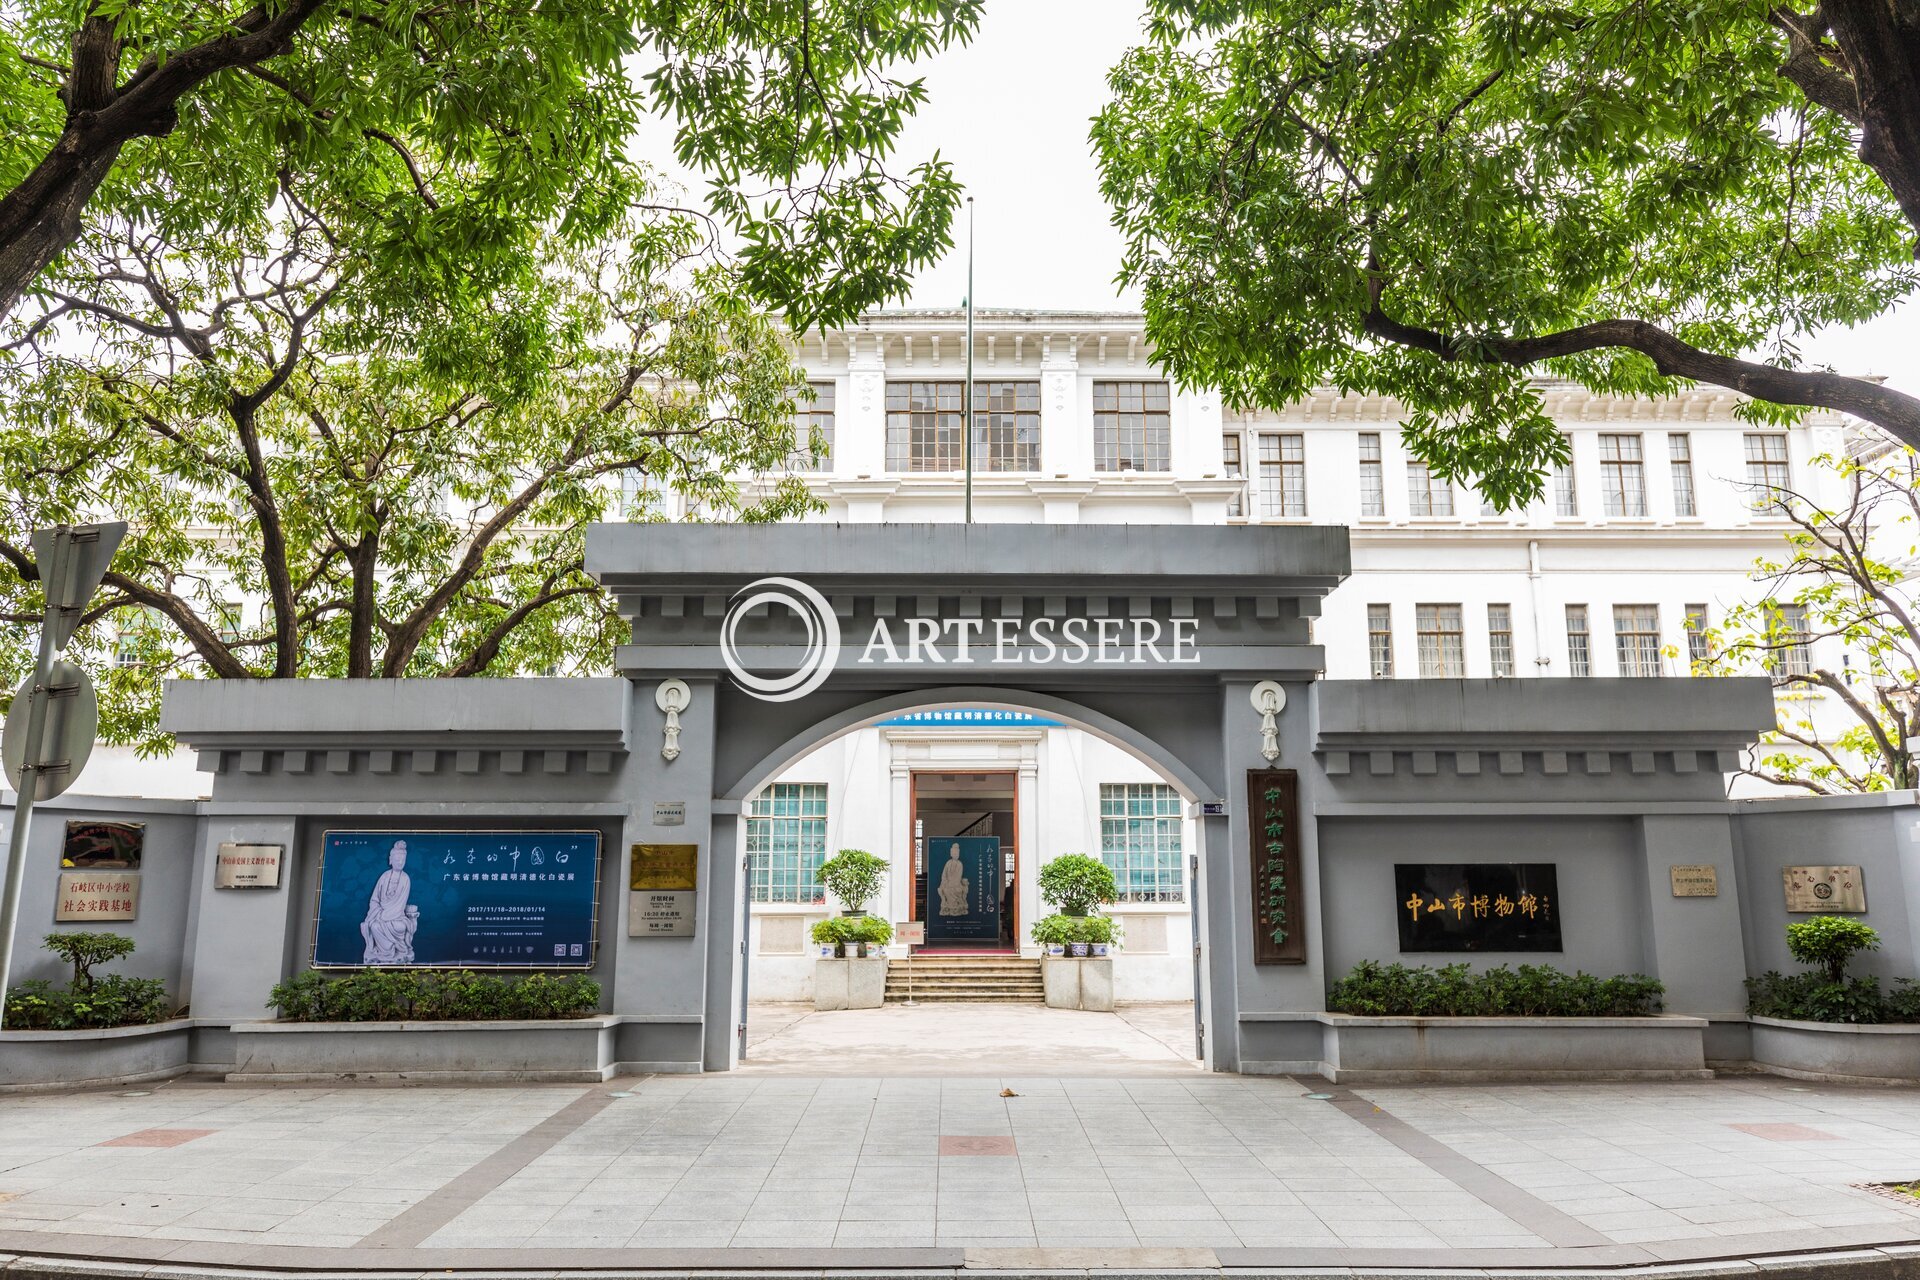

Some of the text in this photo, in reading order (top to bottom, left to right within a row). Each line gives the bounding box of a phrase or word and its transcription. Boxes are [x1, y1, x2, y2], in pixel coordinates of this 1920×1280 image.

[443, 873, 575, 881] 广东省博物馆藏明清德化白瓷展
[70, 882, 130, 893] 石岐区中小学校
[63, 899, 132, 912] 社会实践基地
